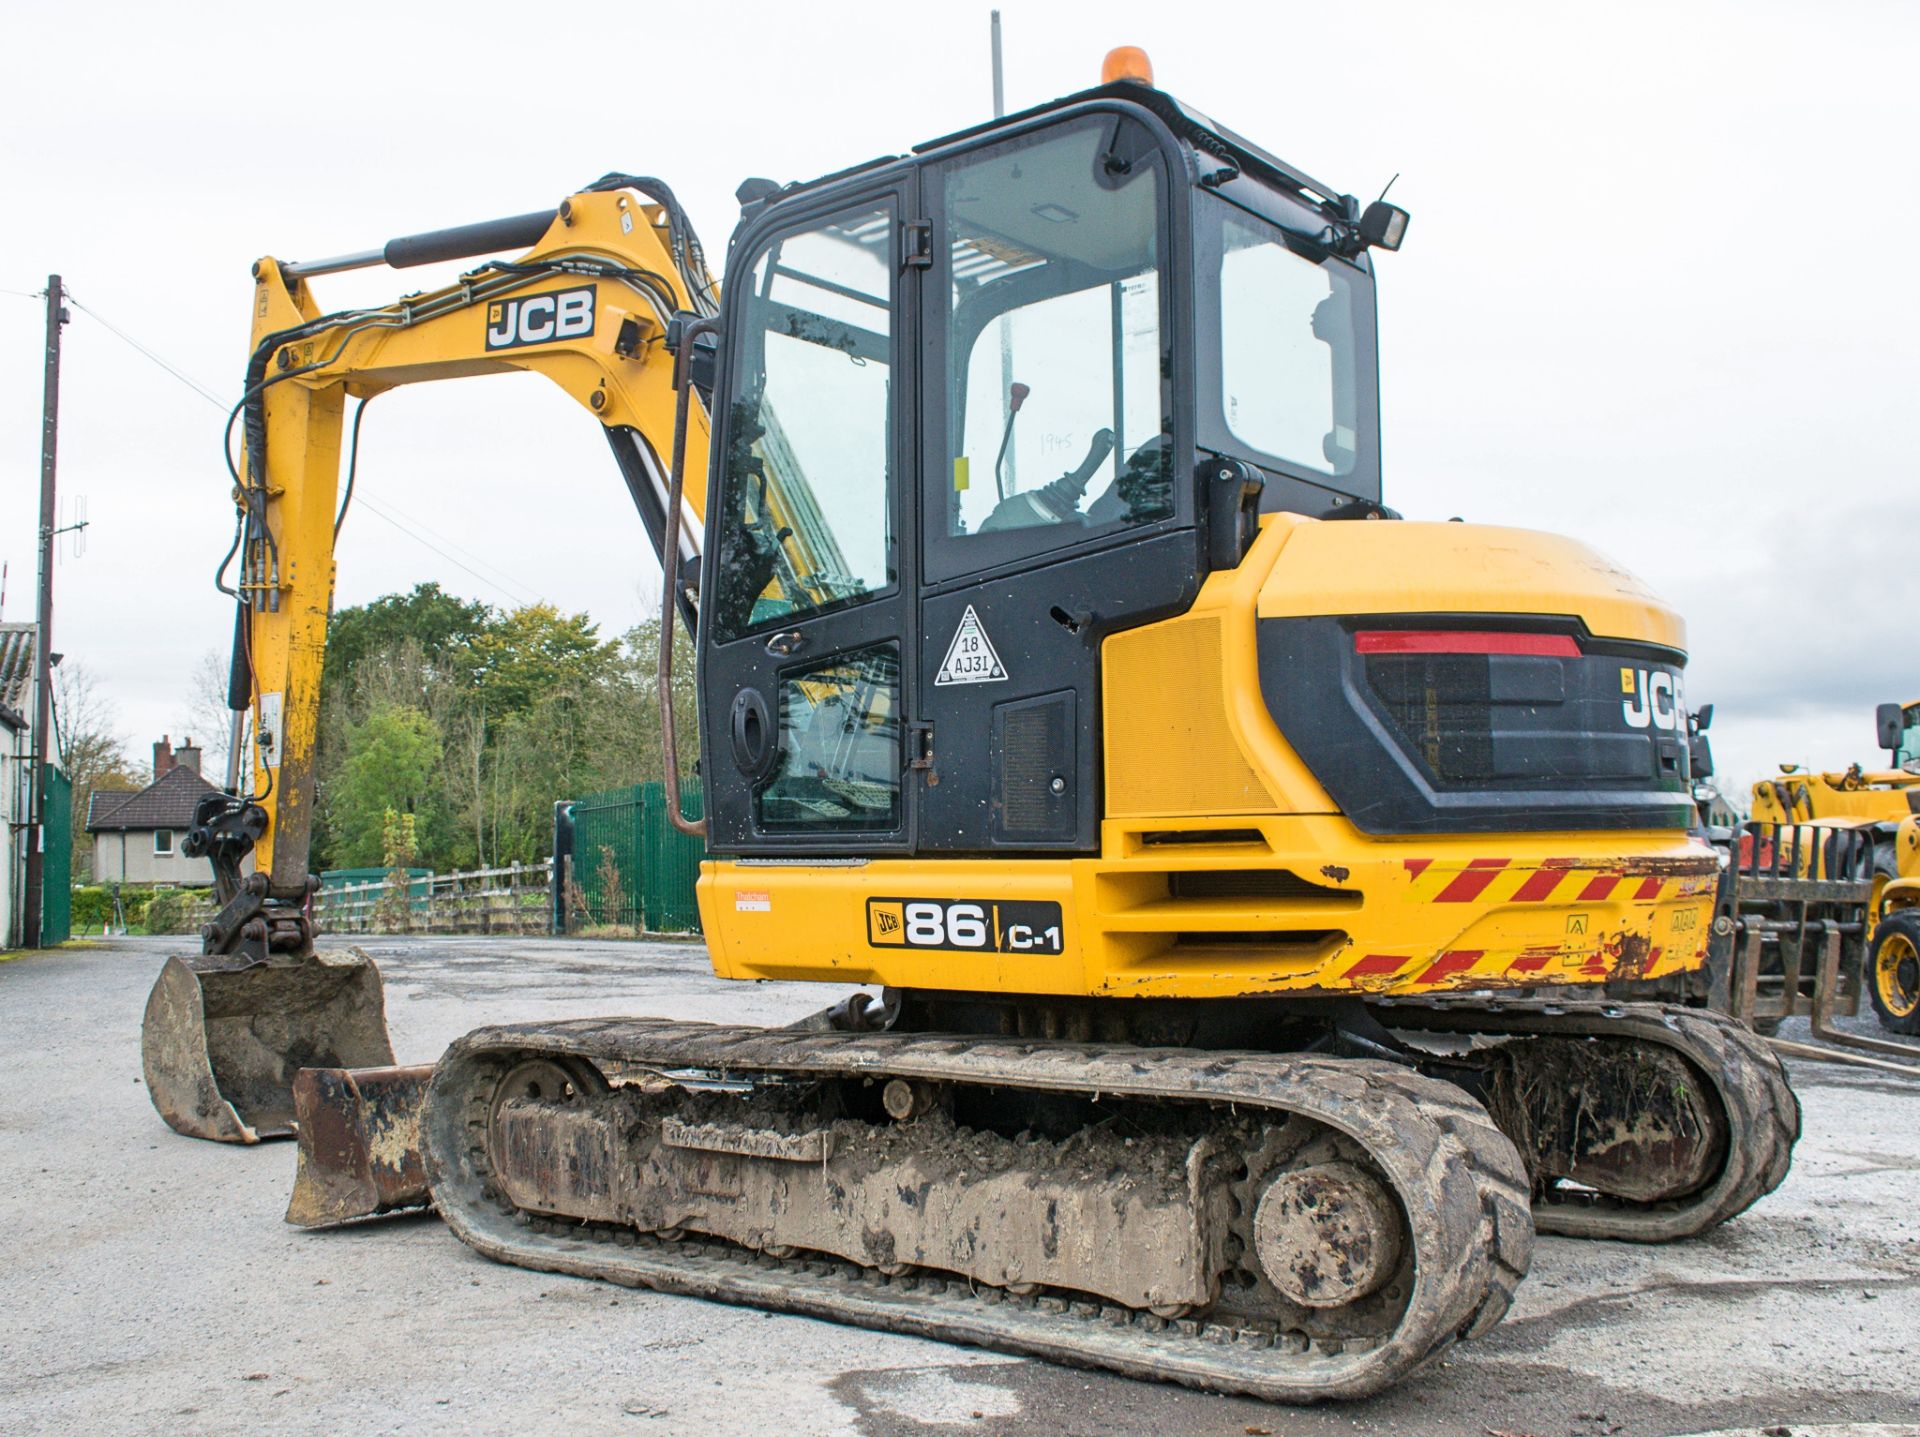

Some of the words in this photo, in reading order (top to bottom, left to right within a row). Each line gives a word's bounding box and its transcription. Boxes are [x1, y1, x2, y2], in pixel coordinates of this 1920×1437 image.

[488, 290, 593, 347] JCB
[961, 636, 979, 653] 18
[878, 912, 900, 932] JCB
[905, 903, 986, 947] 86
[1008, 925, 1061, 950] C-1
